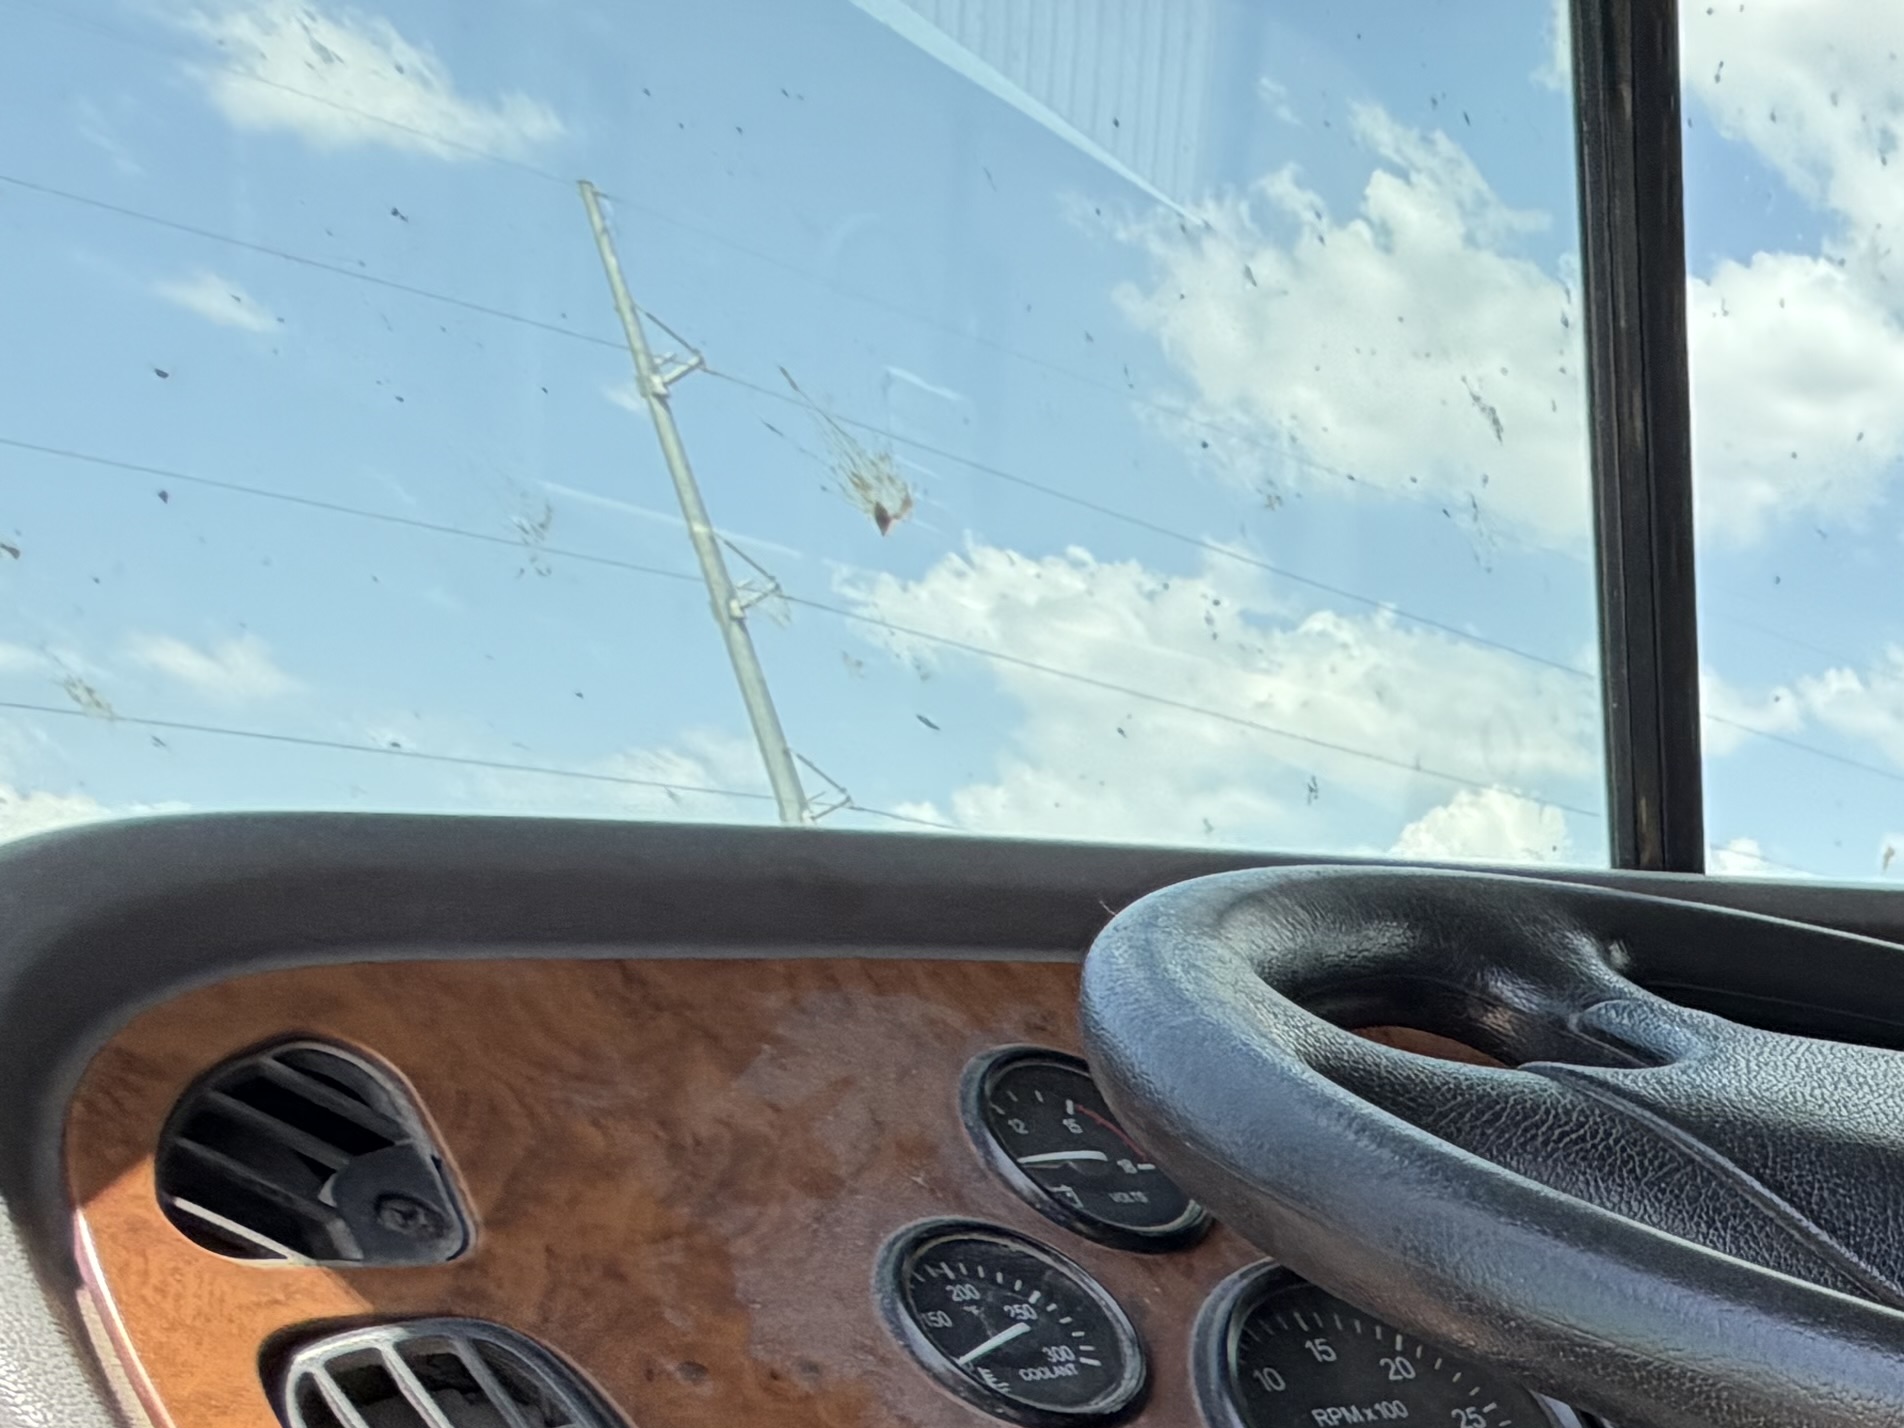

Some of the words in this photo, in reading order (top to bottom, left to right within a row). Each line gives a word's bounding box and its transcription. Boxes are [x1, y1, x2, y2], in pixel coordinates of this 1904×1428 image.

[945, 1283, 981, 1302] 200
[921, 1311, 953, 1328] 150
[1003, 1303, 1038, 1320] 250
[1042, 1345, 1076, 1362] 300
[1305, 1338, 1337, 1362] 15
[1018, 1363, 1079, 1381] COOLANT
[1379, 1356, 1416, 1381] 20
[1253, 1367, 1286, 1392] 10
